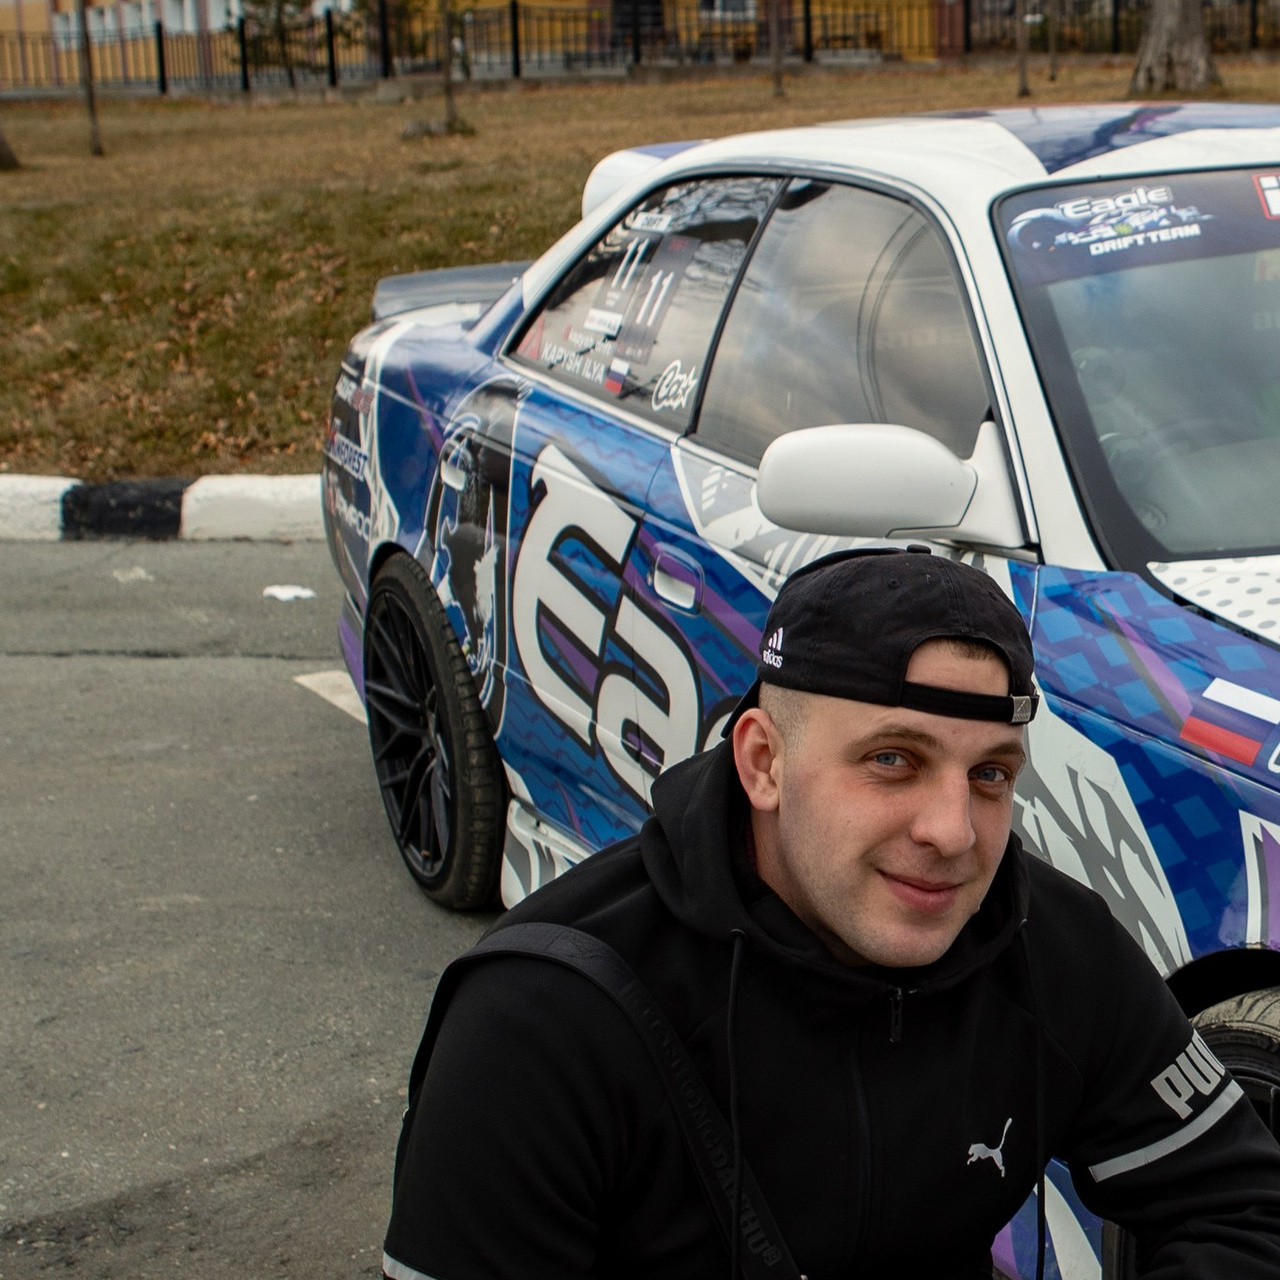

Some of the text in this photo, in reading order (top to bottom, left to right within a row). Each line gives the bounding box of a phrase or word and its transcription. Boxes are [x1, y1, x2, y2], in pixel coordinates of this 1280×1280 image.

[1058, 185, 1172, 218] Eagle
[1090, 223, 1201, 256] DRIFT TEAM
[513, 444, 735, 812] Ea
